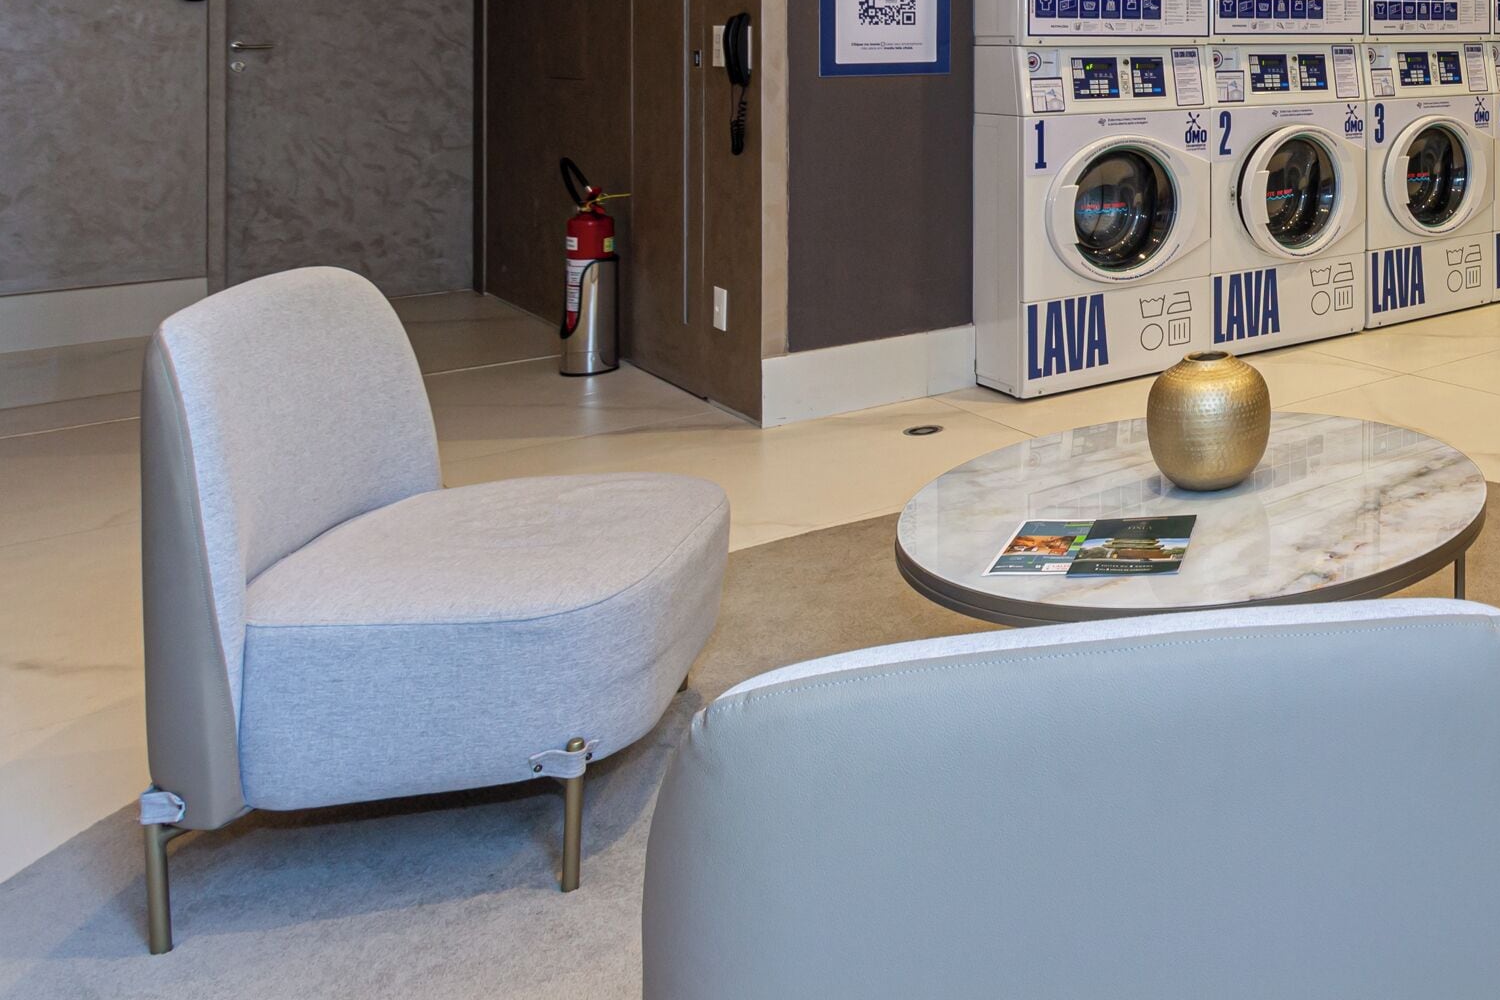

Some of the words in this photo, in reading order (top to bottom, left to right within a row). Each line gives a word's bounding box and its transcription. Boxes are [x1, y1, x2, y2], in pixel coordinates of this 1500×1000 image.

[1185, 129, 1207, 143] OMO
[1219, 111, 1232, 156] 2
[1344, 120, 1364, 133] OMO
[1374, 103, 1384, 143] 3
[1474, 110, 1490, 122] OMO
[1034, 120, 1047, 169] 1
[1371, 245, 1425, 314] LAVA
[1213, 268, 1280, 344] LAVA
[1027, 293, 1109, 380] LAVA
